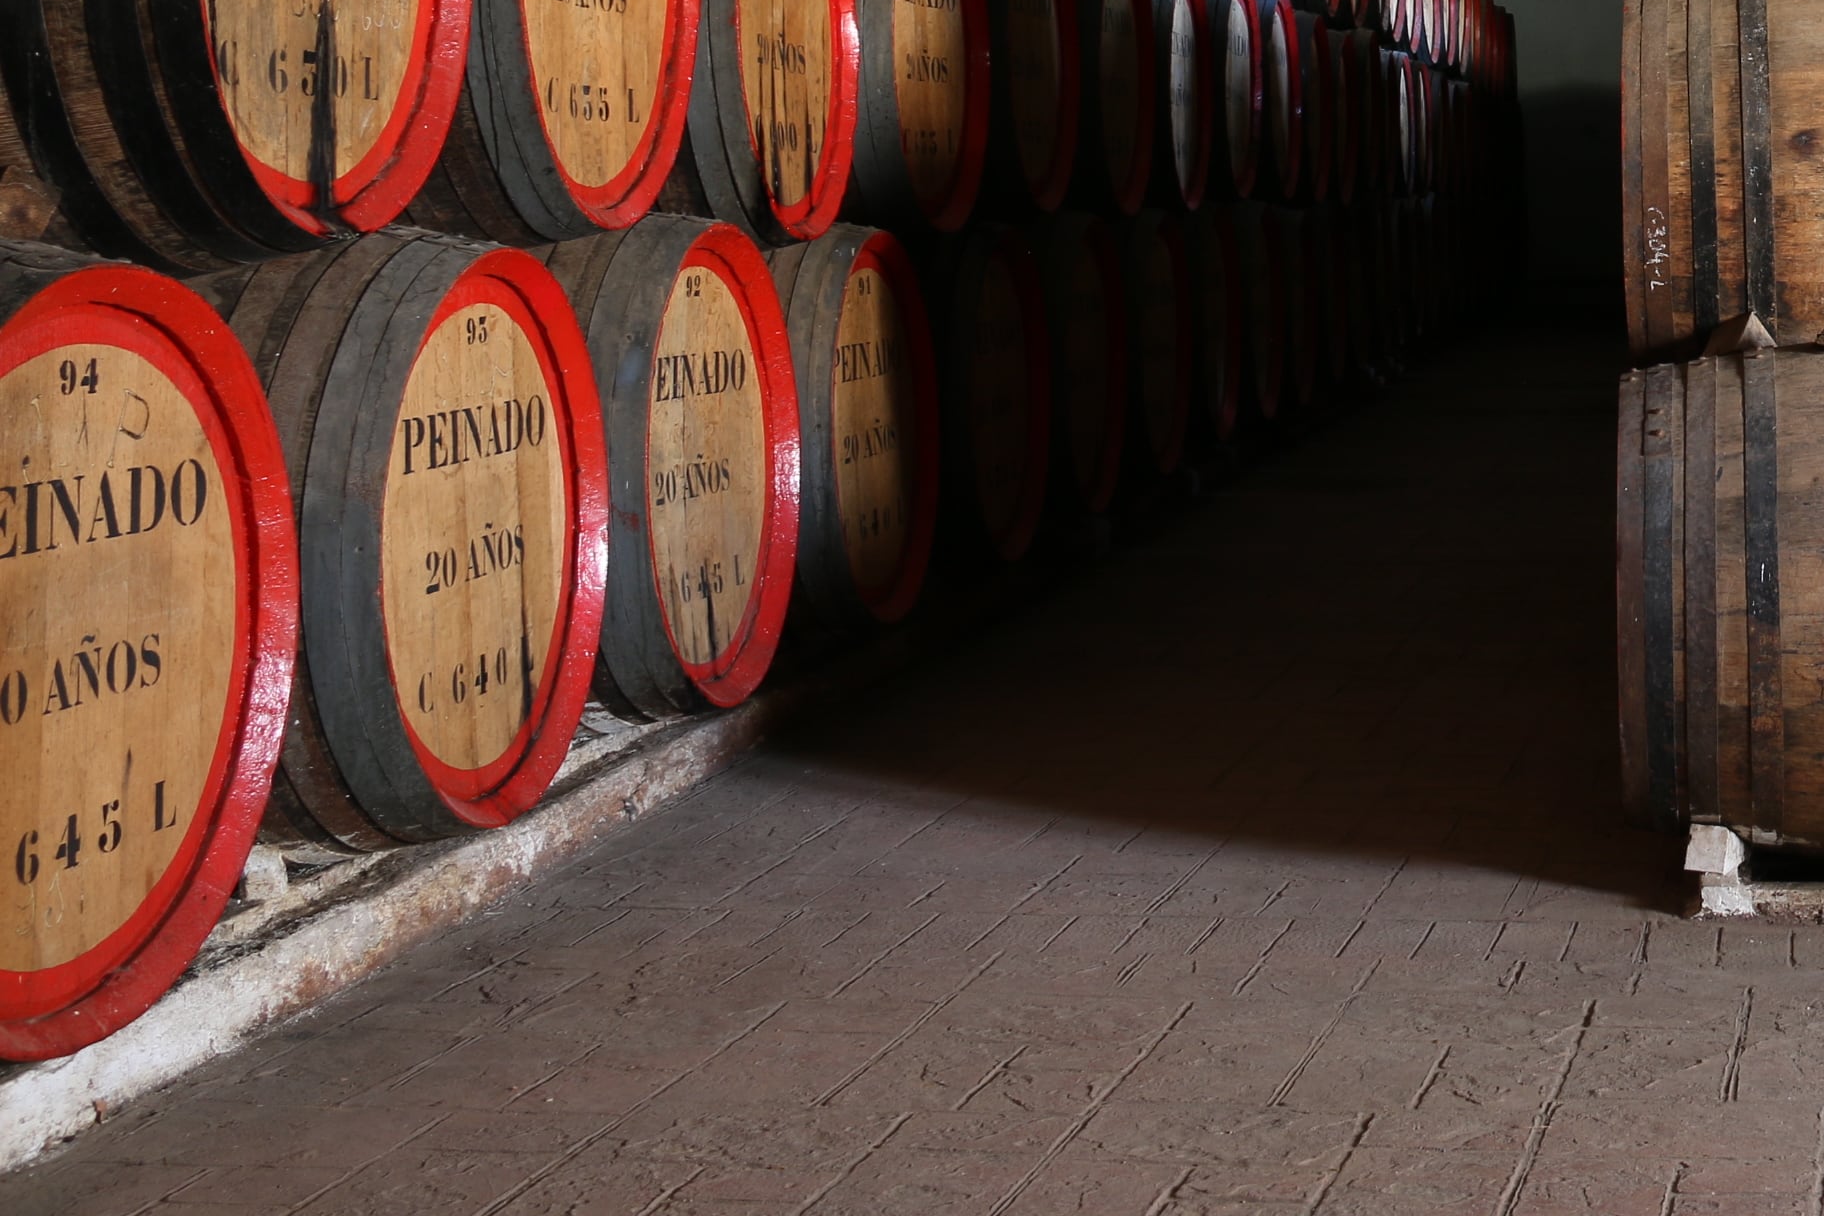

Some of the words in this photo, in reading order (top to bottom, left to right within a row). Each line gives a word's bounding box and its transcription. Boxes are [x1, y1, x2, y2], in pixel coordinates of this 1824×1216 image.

[219, 39, 240, 85] C
[363, 56, 379, 101] L
[547, 77, 559, 114] C
[628, 89, 640, 123] L
[686, 275, 701, 297] 92
[858, 275, 871, 297] 91
[60, 358, 98, 395] 94
[652, 348, 746, 403] EINADO
[402, 394, 545, 475] PEINADO
[843, 434, 859, 465] 20
[655, 469, 676, 506] 20
[681, 453, 730, 503] AÑOS
[425, 548, 457, 594] 20
[464, 522, 524, 583] AÑOS
[734, 554, 745, 586] L
[42, 633, 161, 715] AÑOS
[418, 671, 434, 714] C
[452, 646, 508, 704] 640
[15, 799, 122, 885] 645
[152, 780, 177, 832] L
